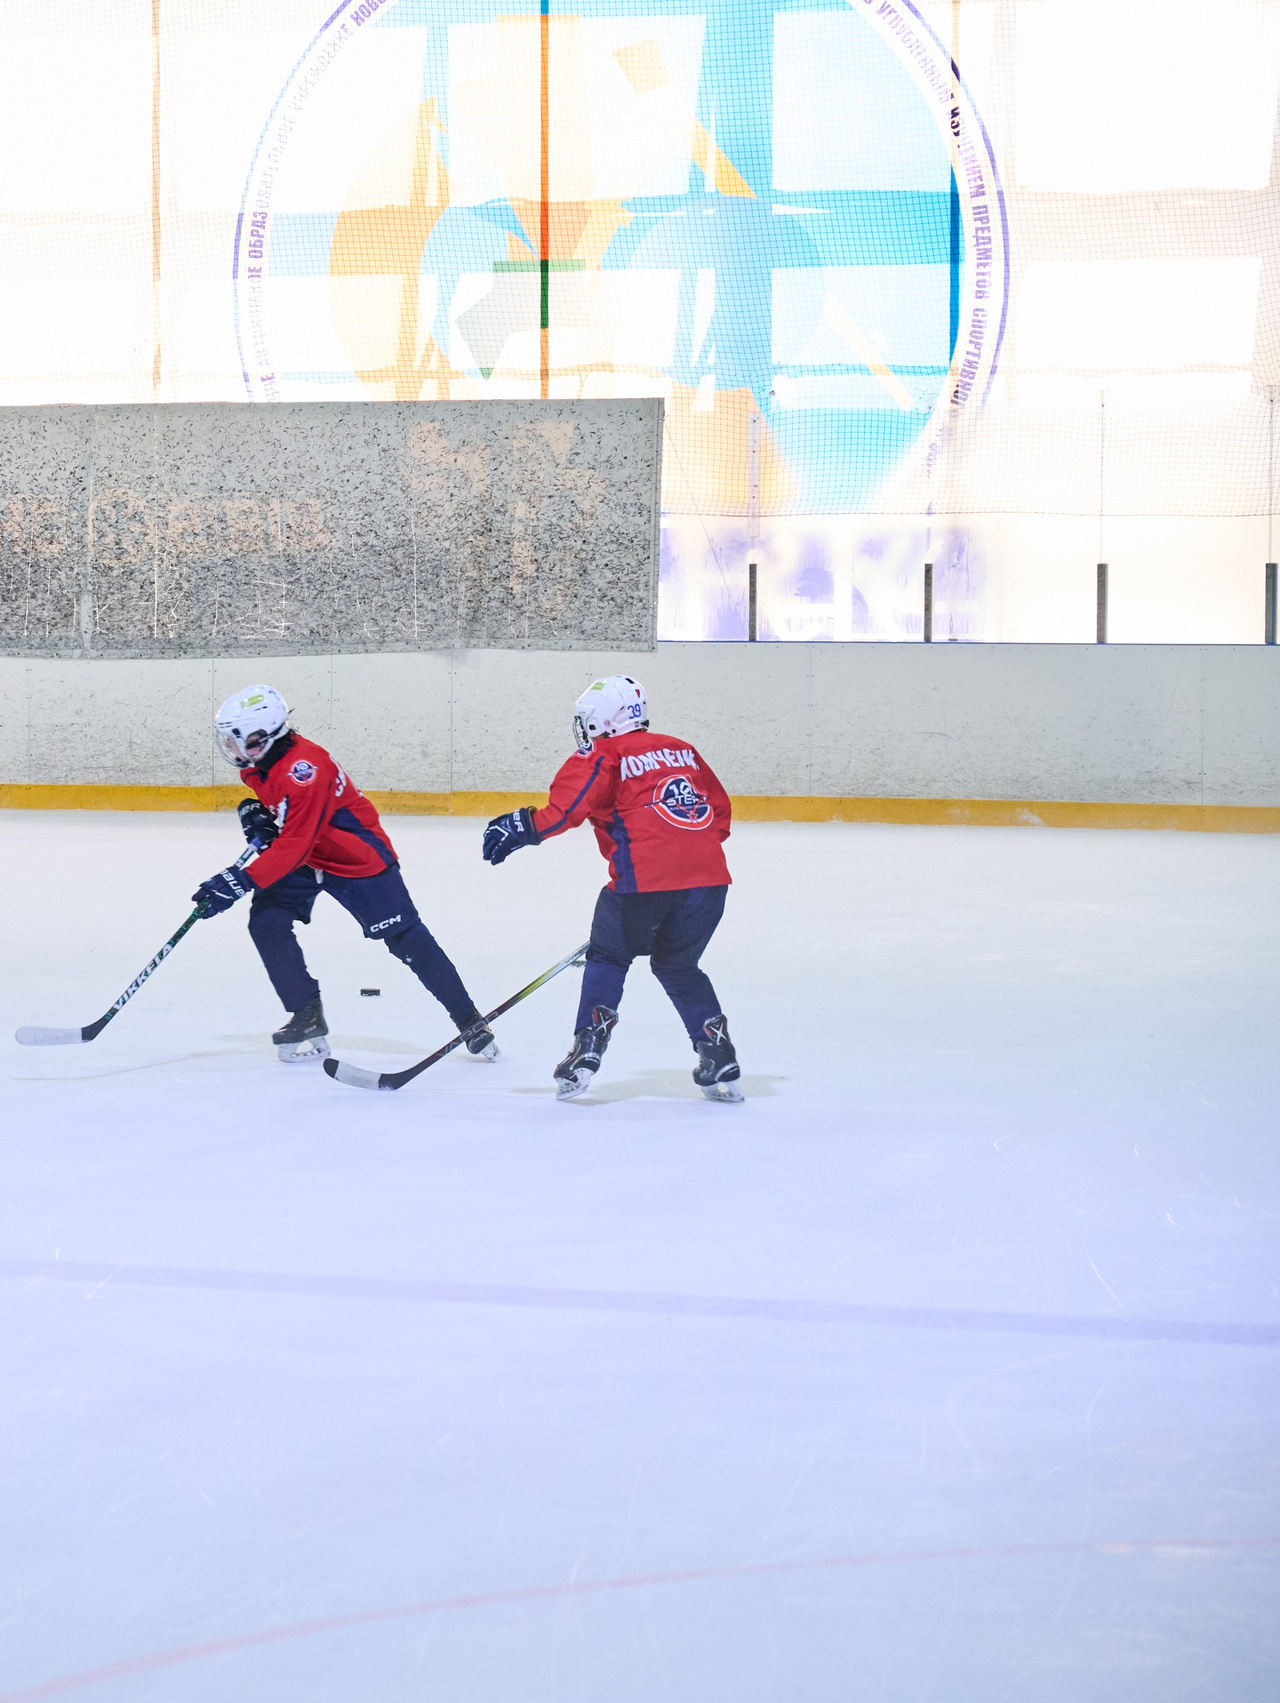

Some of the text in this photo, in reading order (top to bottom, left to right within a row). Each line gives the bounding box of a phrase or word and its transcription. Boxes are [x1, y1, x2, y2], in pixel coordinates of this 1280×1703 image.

[971, 204, 993, 300] ПРЕДМЕТОВ
[627, 703, 642, 720] 39
[370, 914, 402, 933] CCM
[113, 943, 173, 1010] VIKKELA
